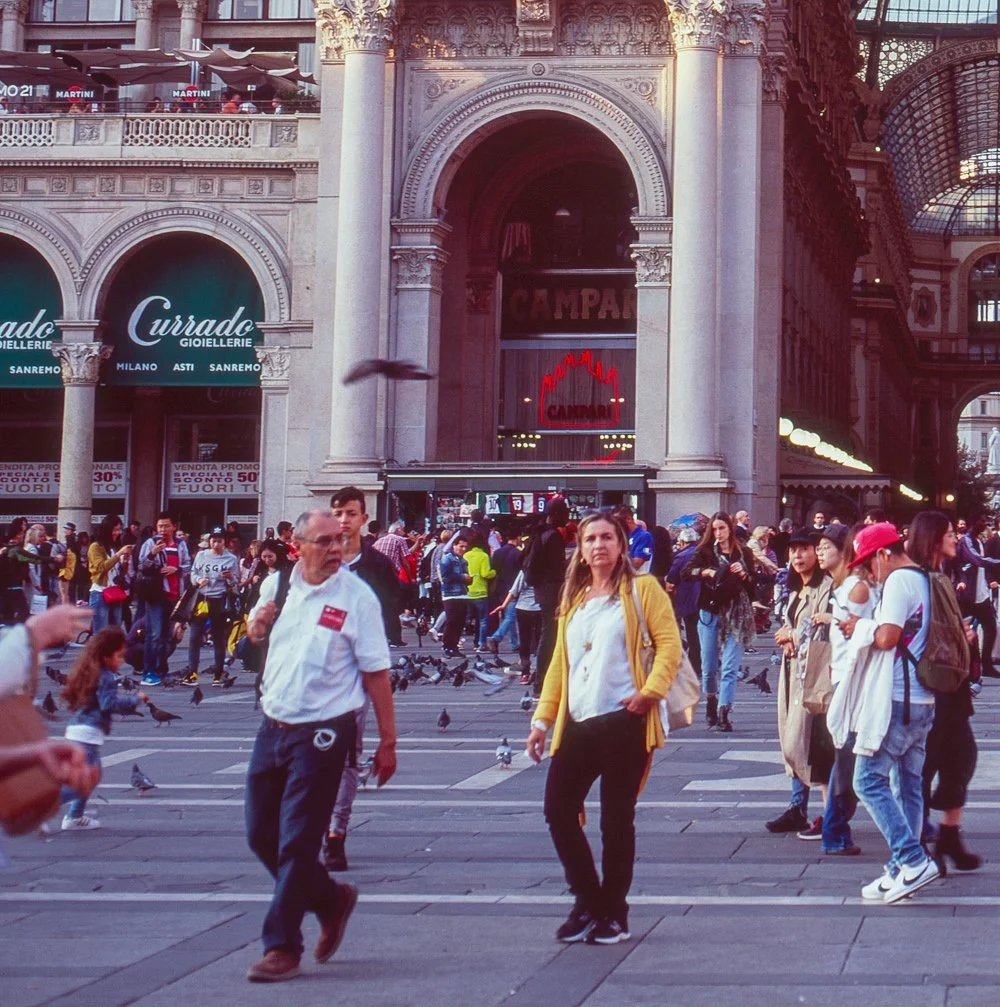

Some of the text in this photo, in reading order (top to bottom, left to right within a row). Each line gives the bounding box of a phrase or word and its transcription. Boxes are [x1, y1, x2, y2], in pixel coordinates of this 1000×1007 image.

[20, 85, 33, 97] 21
[56, 90, 94, 98] MARTINI
[172, 90, 211, 98] MARTINI
[0, 309, 54, 339] ado
[127, 295, 254, 346] Currado
[0, 340, 52, 350] IELLERIE
[179, 338, 252, 347] GIOIELLERIE
[9, 365, 61, 374] SANREMO
[116, 363, 261, 372] MILANO ASTI SANREMO
[547, 404, 611, 420] CAMPARI
[0, 463, 34, 471] ENDITA
[174, 463, 218, 471] VENDITA
[93, 472, 122, 482] 30%
[237, 472, 259, 482] 50
[512, 499, 522, 511] 19
[538, 500, 545, 512] 9
